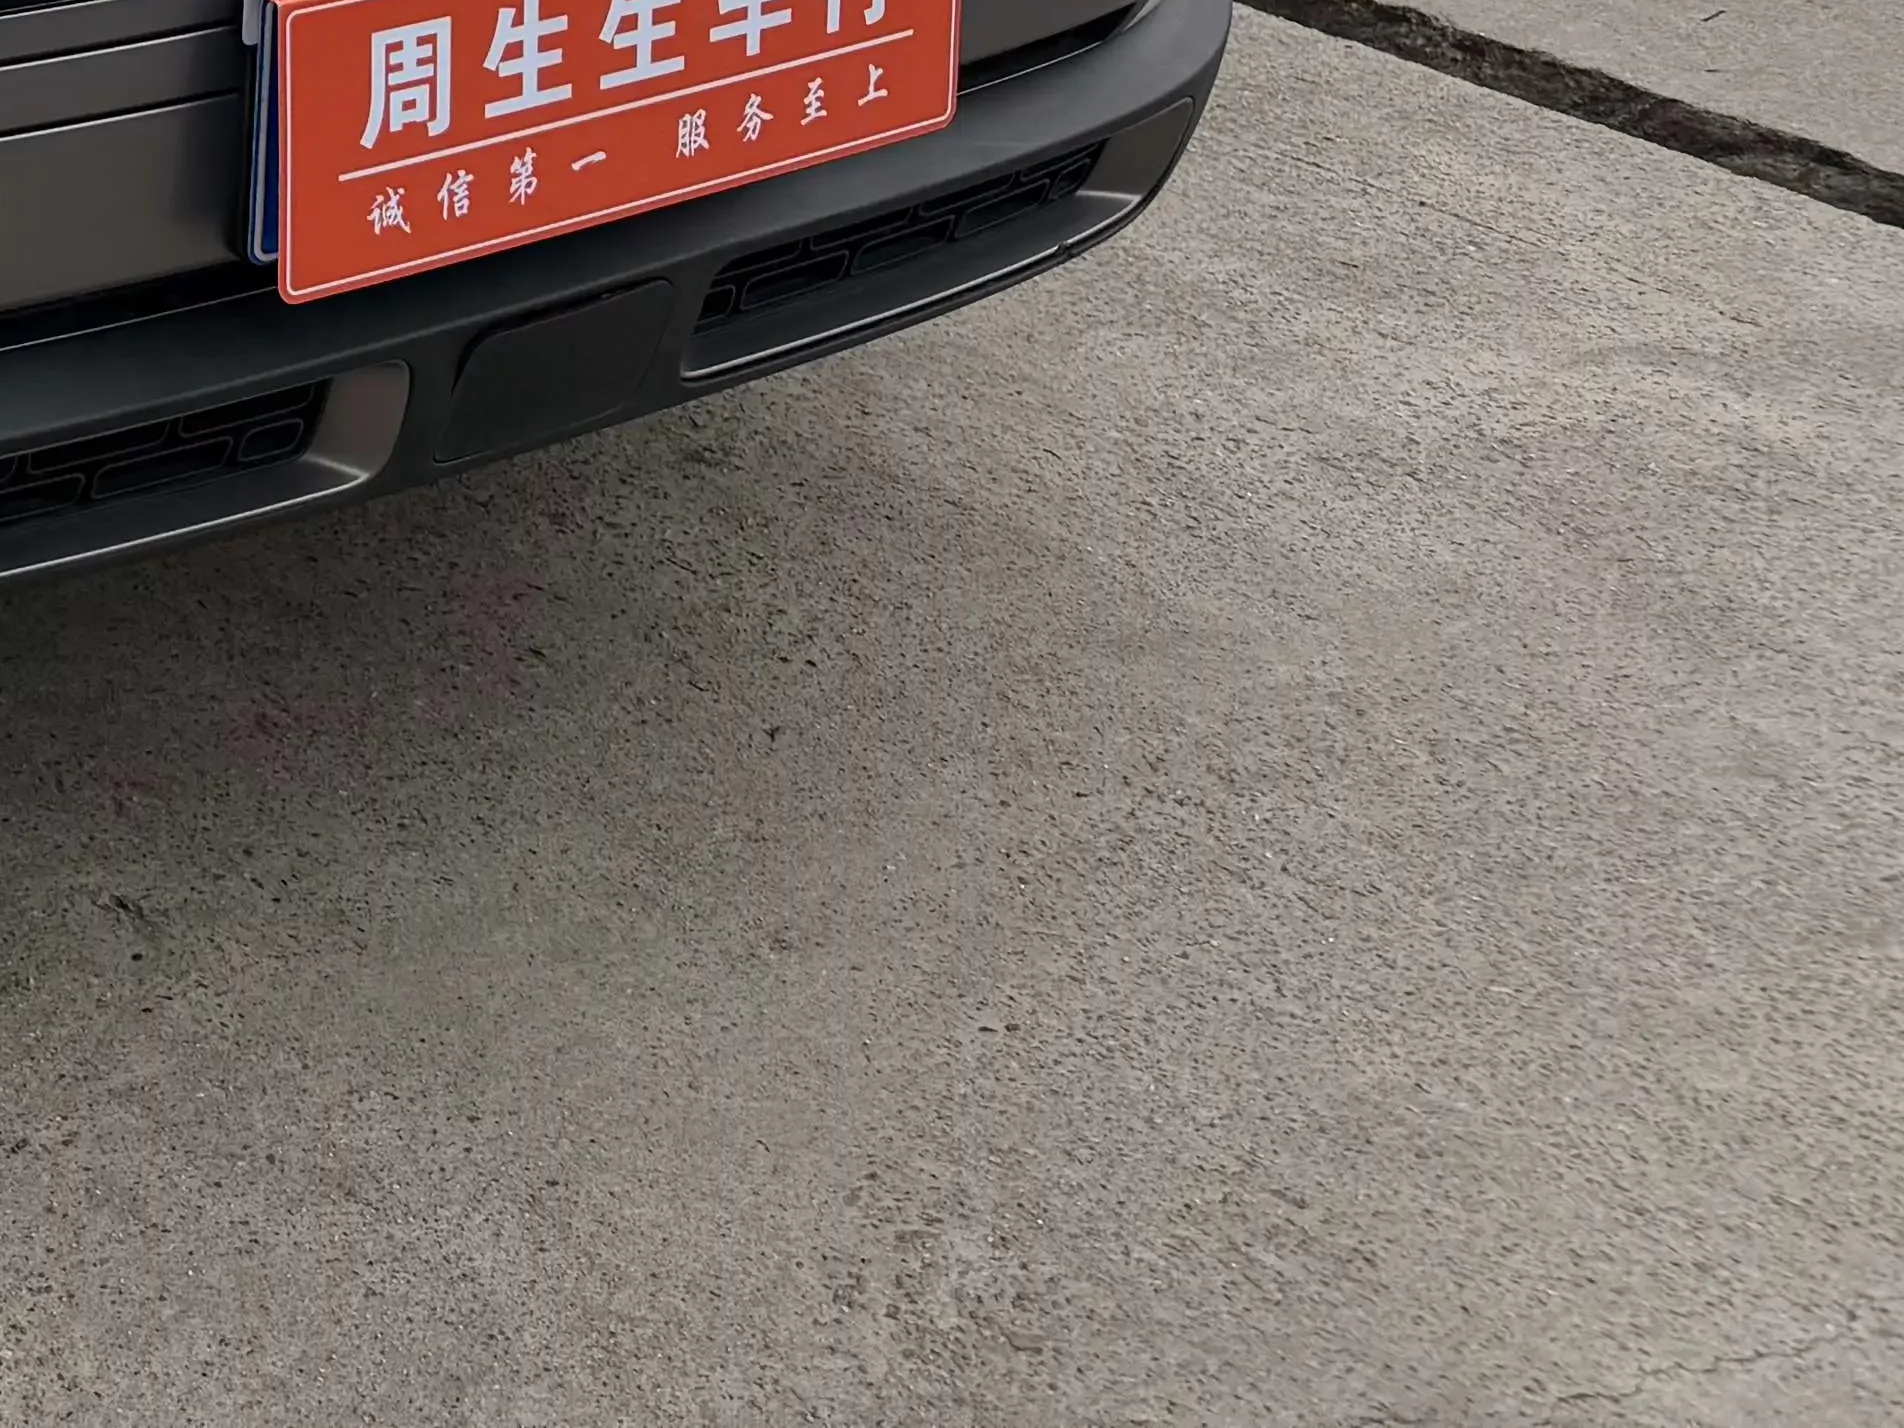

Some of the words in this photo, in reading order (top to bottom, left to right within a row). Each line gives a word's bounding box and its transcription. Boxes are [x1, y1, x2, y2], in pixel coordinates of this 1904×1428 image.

[366, 147, 608, 236] 诚信第一
[675, 62, 889, 160] 服务至上
